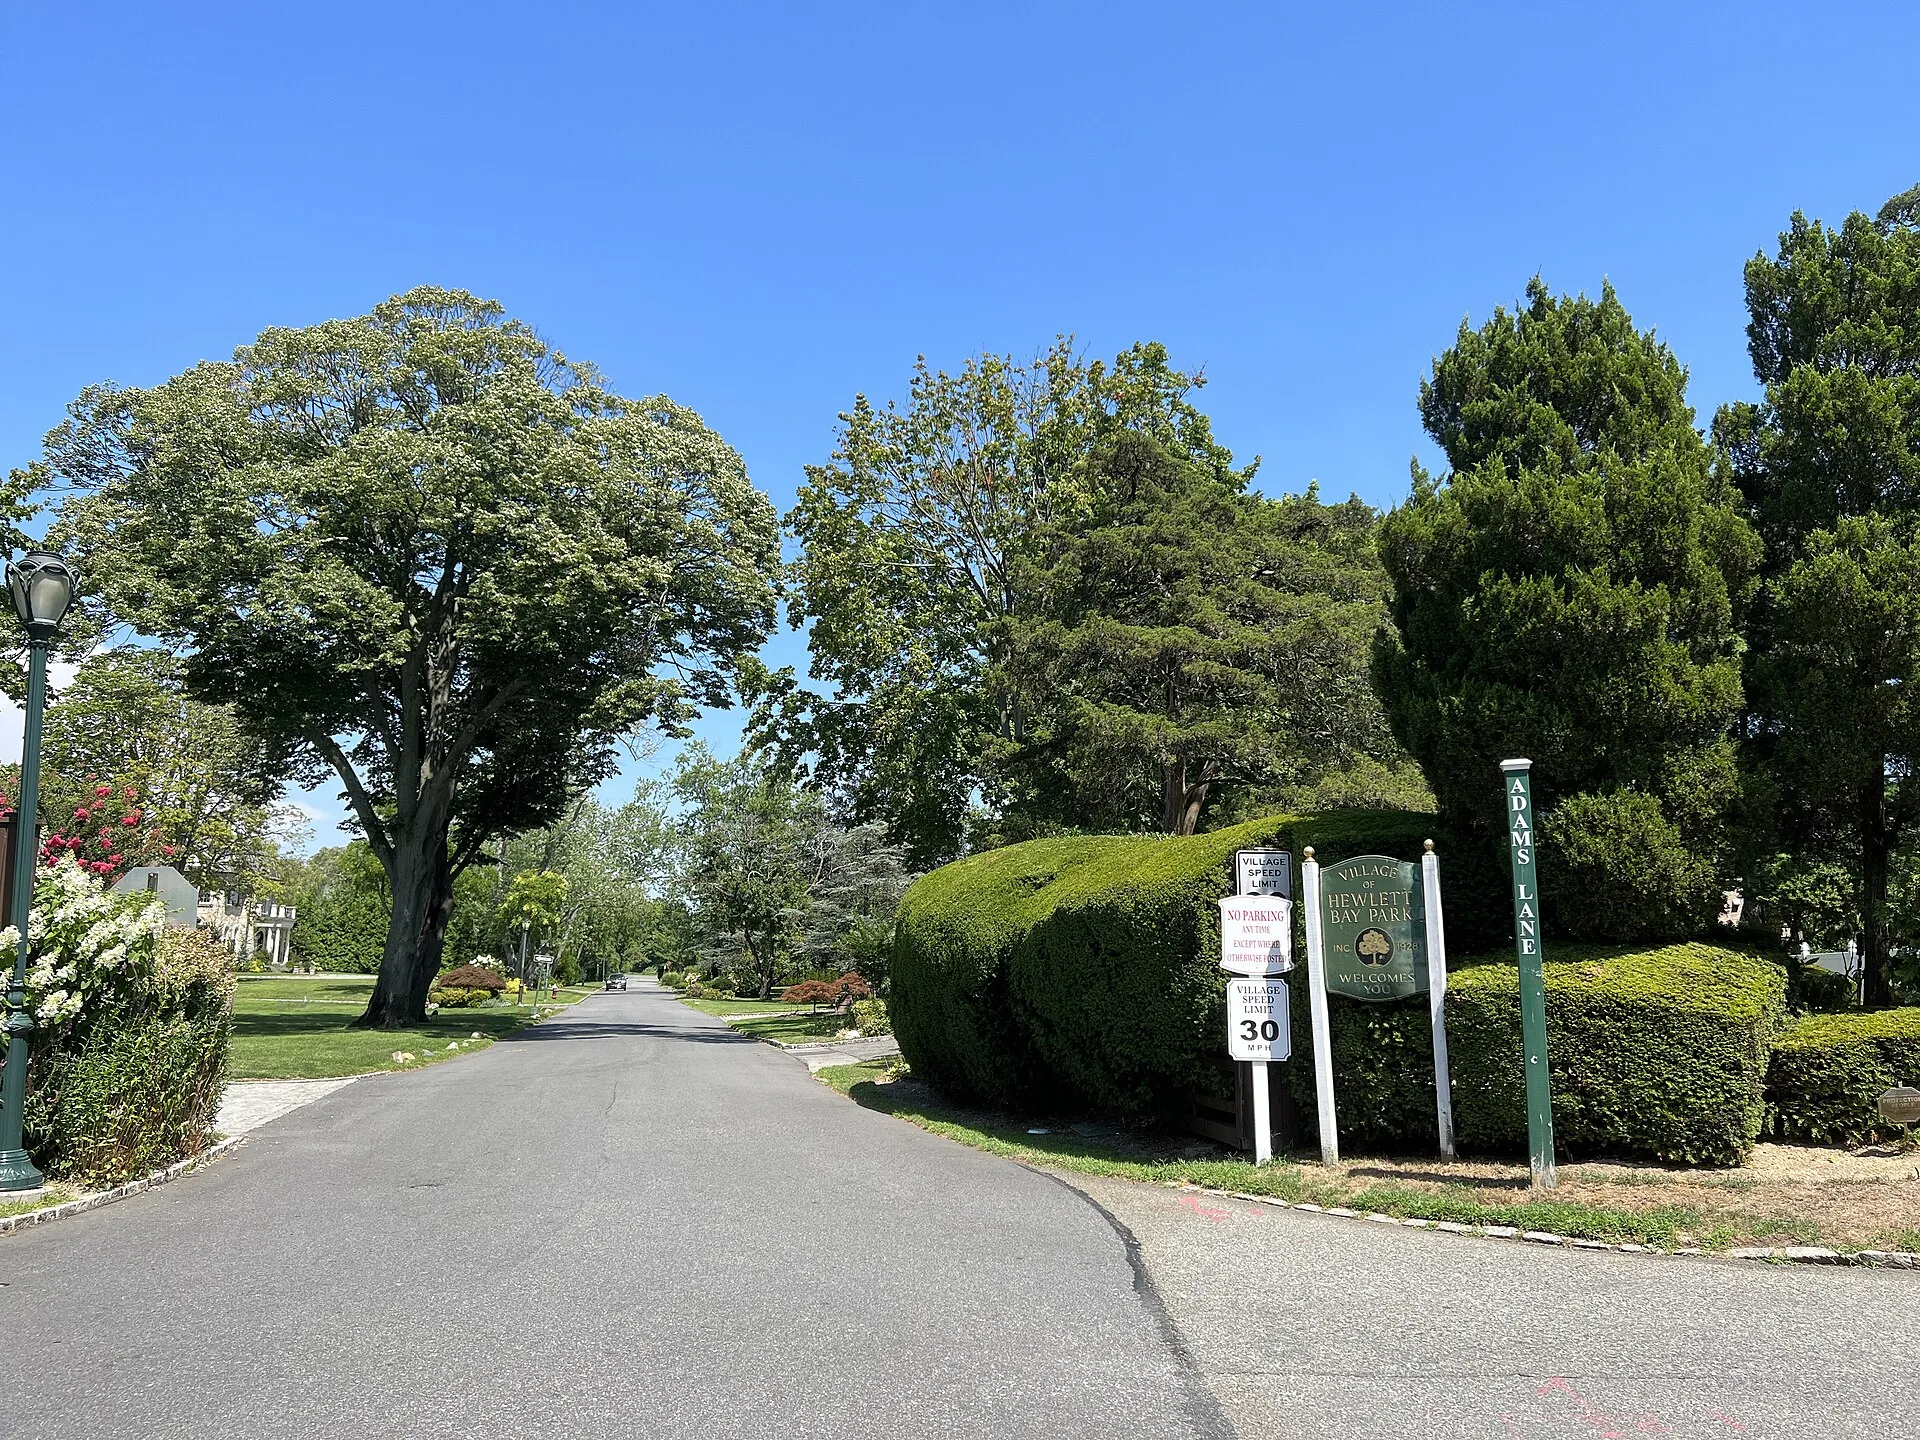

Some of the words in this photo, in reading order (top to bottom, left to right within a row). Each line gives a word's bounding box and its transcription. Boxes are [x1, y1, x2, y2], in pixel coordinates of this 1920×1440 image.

[1510, 777, 1531, 864] ADAMS
[1242, 857, 1287, 866] VILLAGE
[1248, 869, 1282, 877] SPEED
[1338, 865, 1399, 881] VILLAGE
[1252, 880, 1278, 888] LIMIT
[1362, 880, 1375, 889] OF
[1328, 891, 1413, 908] HEWLETT
[1227, 909, 1241, 921] NO
[1242, 910, 1284, 922] PARKING
[1330, 908, 1361, 924] BAY
[1368, 907, 1412, 923] PARK
[1518, 884, 1536, 955] LANE
[1241, 925, 1255, 934] ANY
[1255, 925, 1271, 934] TIME
[1233, 940, 1257, 948] EXCEPT
[1257, 940, 1280, 949] WHERE
[1396, 942, 1419, 951] 1928
[1226, 953, 1263, 963] OTHERWISE
[1263, 954, 1287, 963] POSTED
[1339, 973, 1415, 983] WELCOMES
[1237, 986, 1280, 995] VILLAGE
[1363, 985, 1391, 995] YOU
[1242, 995, 1275, 1004] SPEED
[1244, 1005, 1274, 1014] LIMIT
[1239, 1019, 1280, 1042] 30
